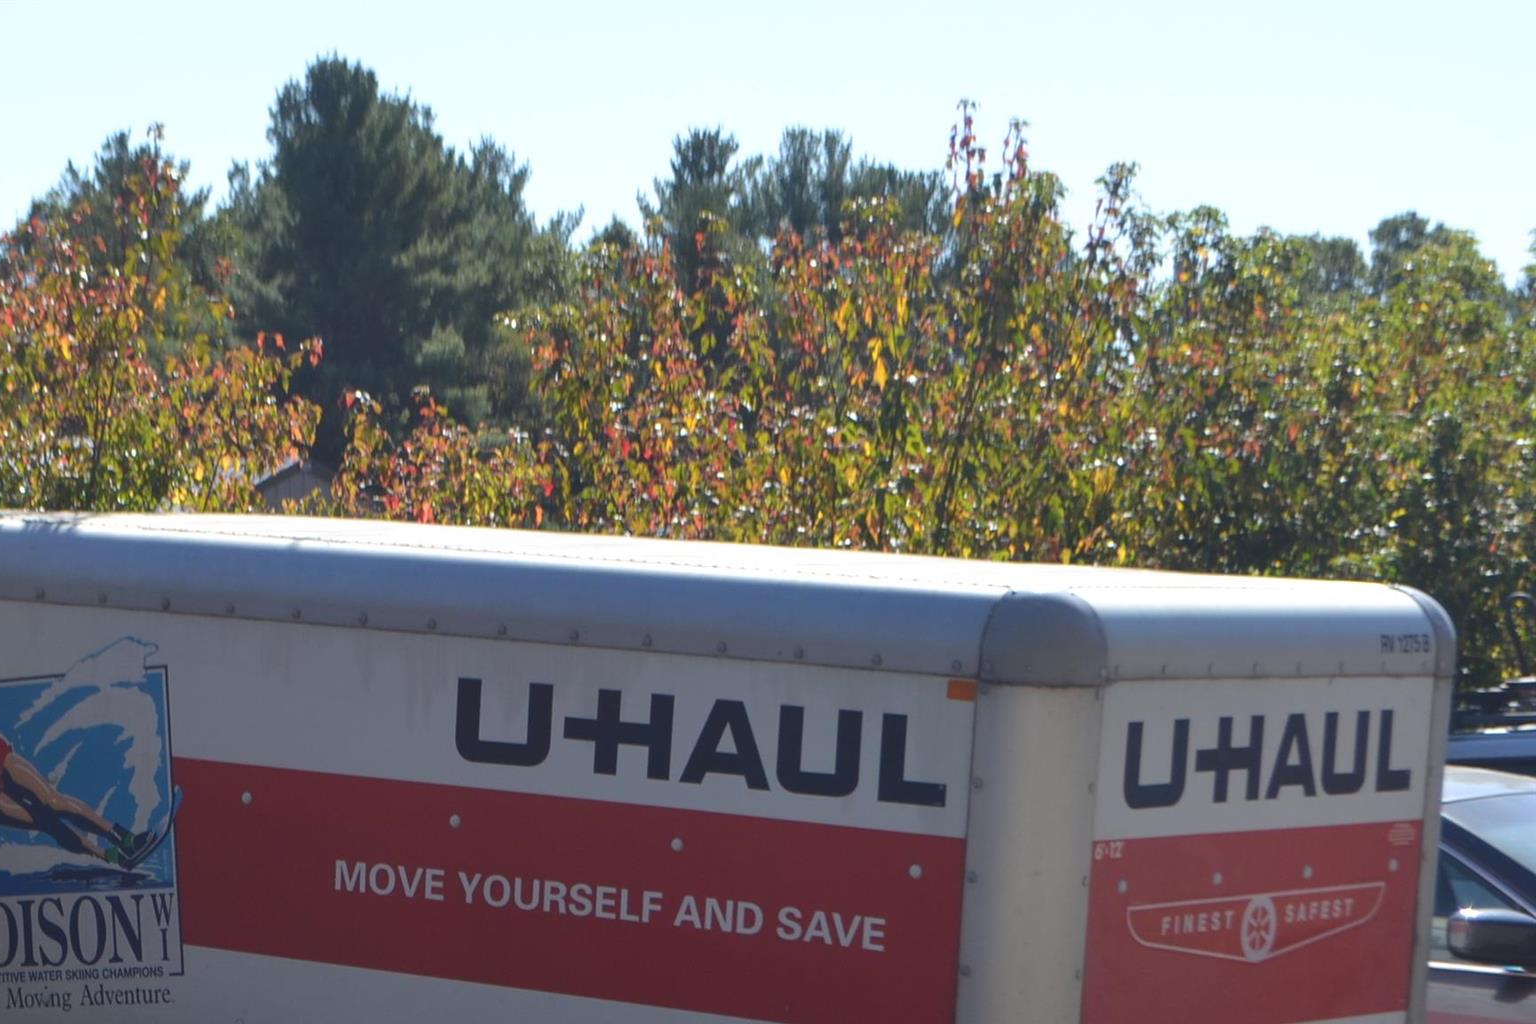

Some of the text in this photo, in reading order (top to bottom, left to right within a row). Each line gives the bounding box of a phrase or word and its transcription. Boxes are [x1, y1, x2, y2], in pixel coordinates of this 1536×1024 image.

[455, 677, 947, 808] U-HAUL
[1123, 709, 1411, 810] U-HAUL
[334, 859, 886, 952] MOVE YOURSELF AND SAVE
[1160, 898, 1354, 936] FINEST SAFEST
[7, 985, 72, 1012] Moving
[28, 969, 62, 982] WATER
[65, 968, 99, 981] SKIING
[102, 966, 163, 979] CHAMPIONS
